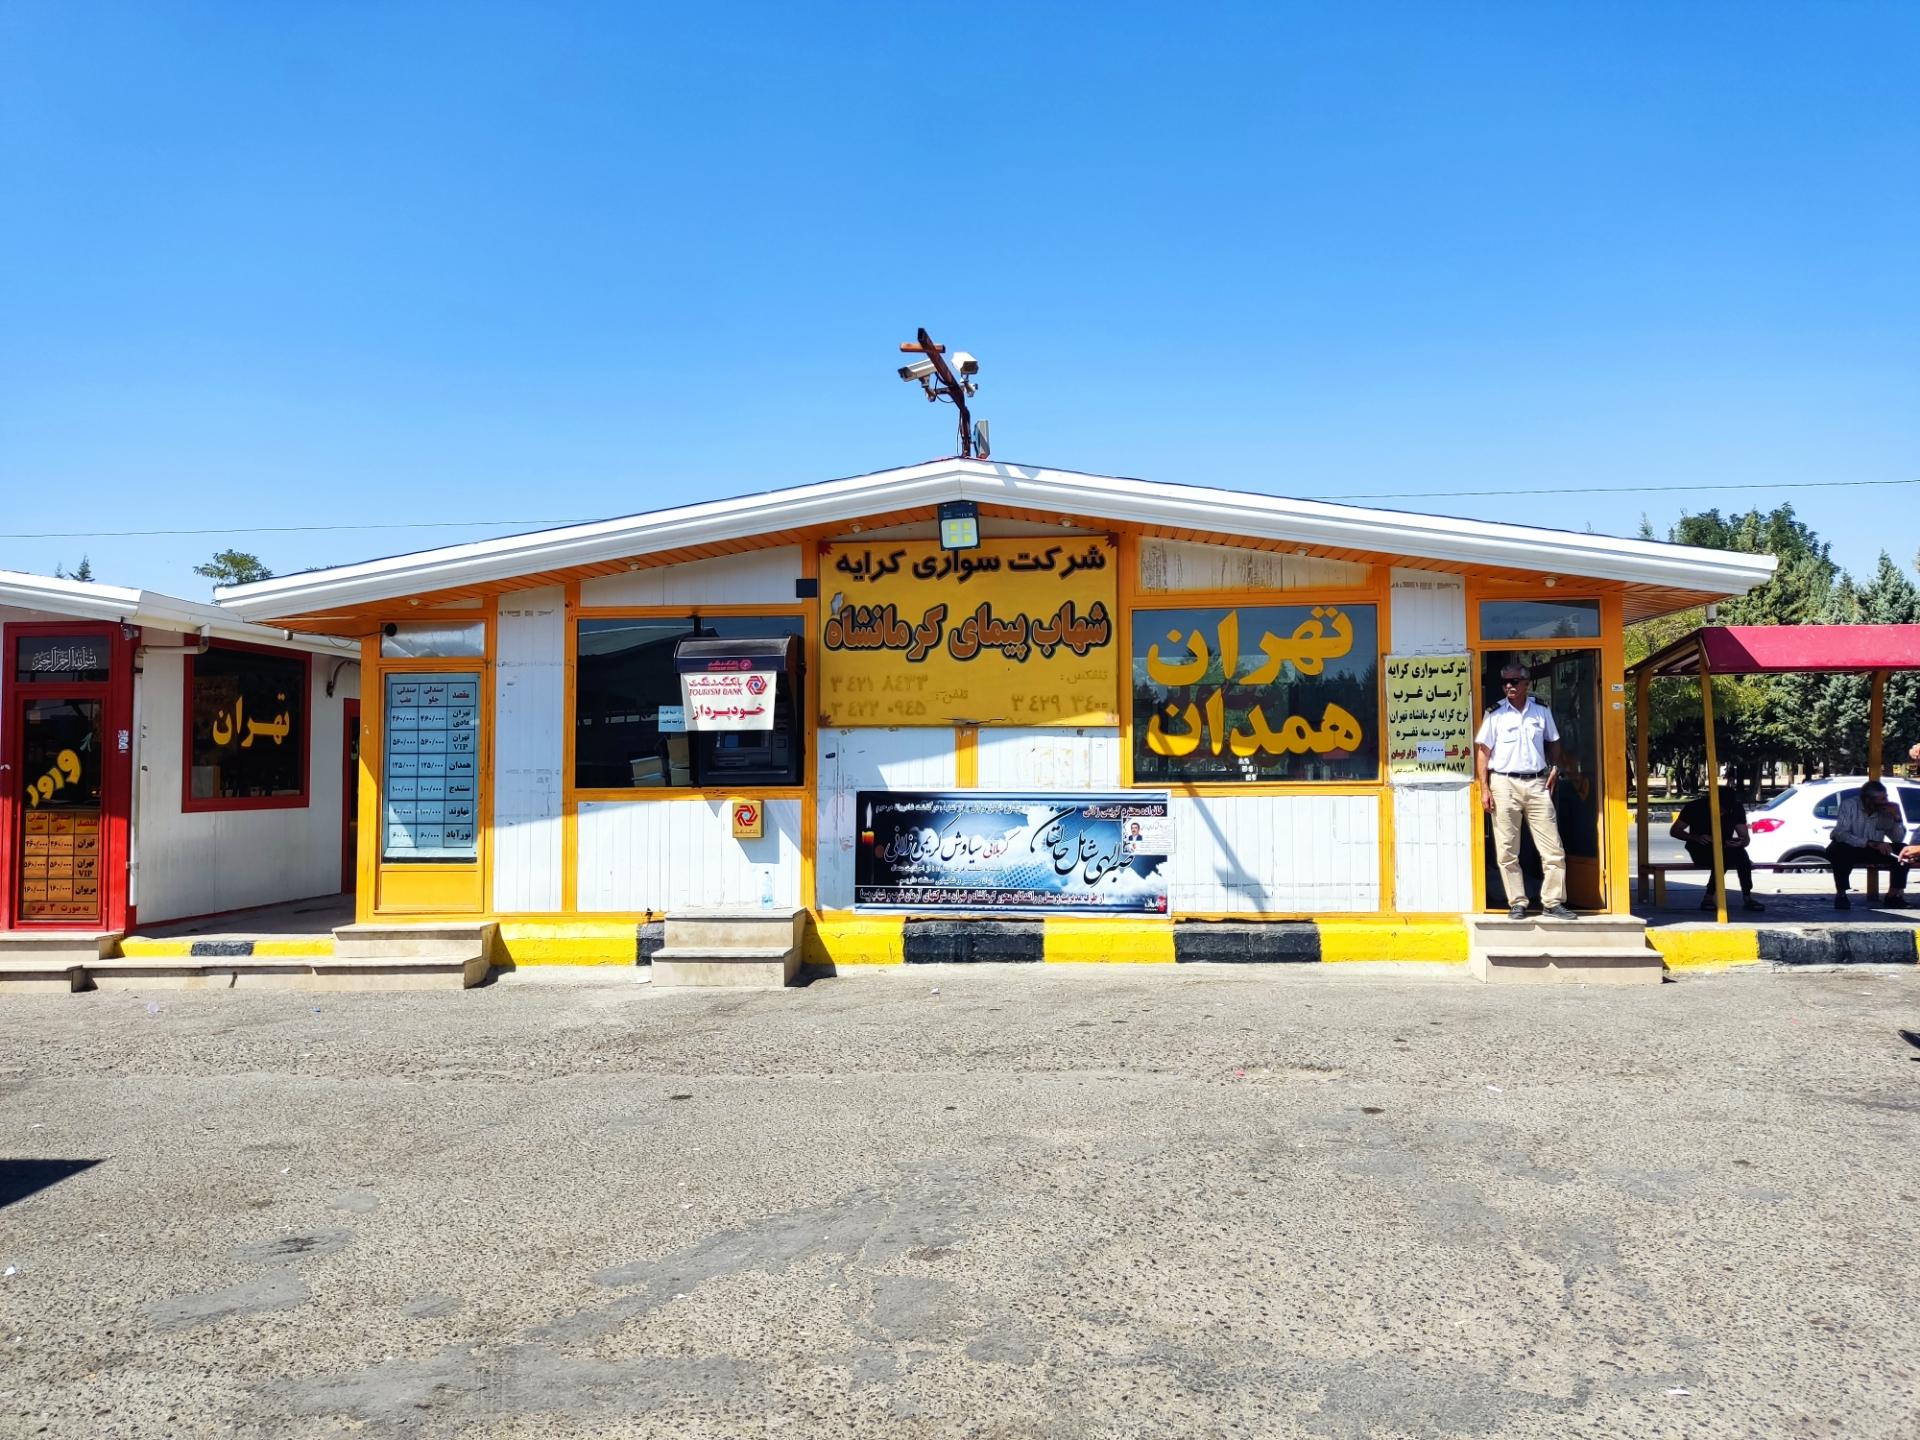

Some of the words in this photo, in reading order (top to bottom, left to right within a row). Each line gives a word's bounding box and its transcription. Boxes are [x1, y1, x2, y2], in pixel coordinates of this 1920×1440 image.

[835, 550, 907, 582] کرایه
[912, 549, 1001, 582] سواری
[1007, 544, 1107, 579] شرکت
[822, 601, 948, 663] کرمانشاه
[948, 600, 1031, 663] پیمای
[1030, 599, 1113, 659] شهاب
[1146, 606, 1354, 686] تهران
[1388, 663, 1409, 678] کرایه
[1411, 662, 1439, 678] سواری
[1441, 661, 1467, 677] شرکت
[688, 688, 721, 696] TOURISM
[722, 688, 743, 696] BANK
[1393, 685, 1423, 702] غرب
[1425, 683, 1463, 702] آرمان
[212, 692, 290, 747] تهران
[1147, 687, 1363, 757] همدان
[1390, 709, 1408, 723] تهران
[1409, 709, 1436, 722] کرمانشاه
[1438, 709, 1454, 722] کرایه
[1457, 708, 1469, 722] نرخ
[1396, 726, 1418, 740] نفره
[1420, 730, 1430, 738] سه
[1432, 727, 1456, 739] صورت
[1458, 728, 1466, 738] به
[448, 761, 471, 771] همدان
[448, 784, 471, 793] سنندج
[448, 806, 469, 817] نهاوند
